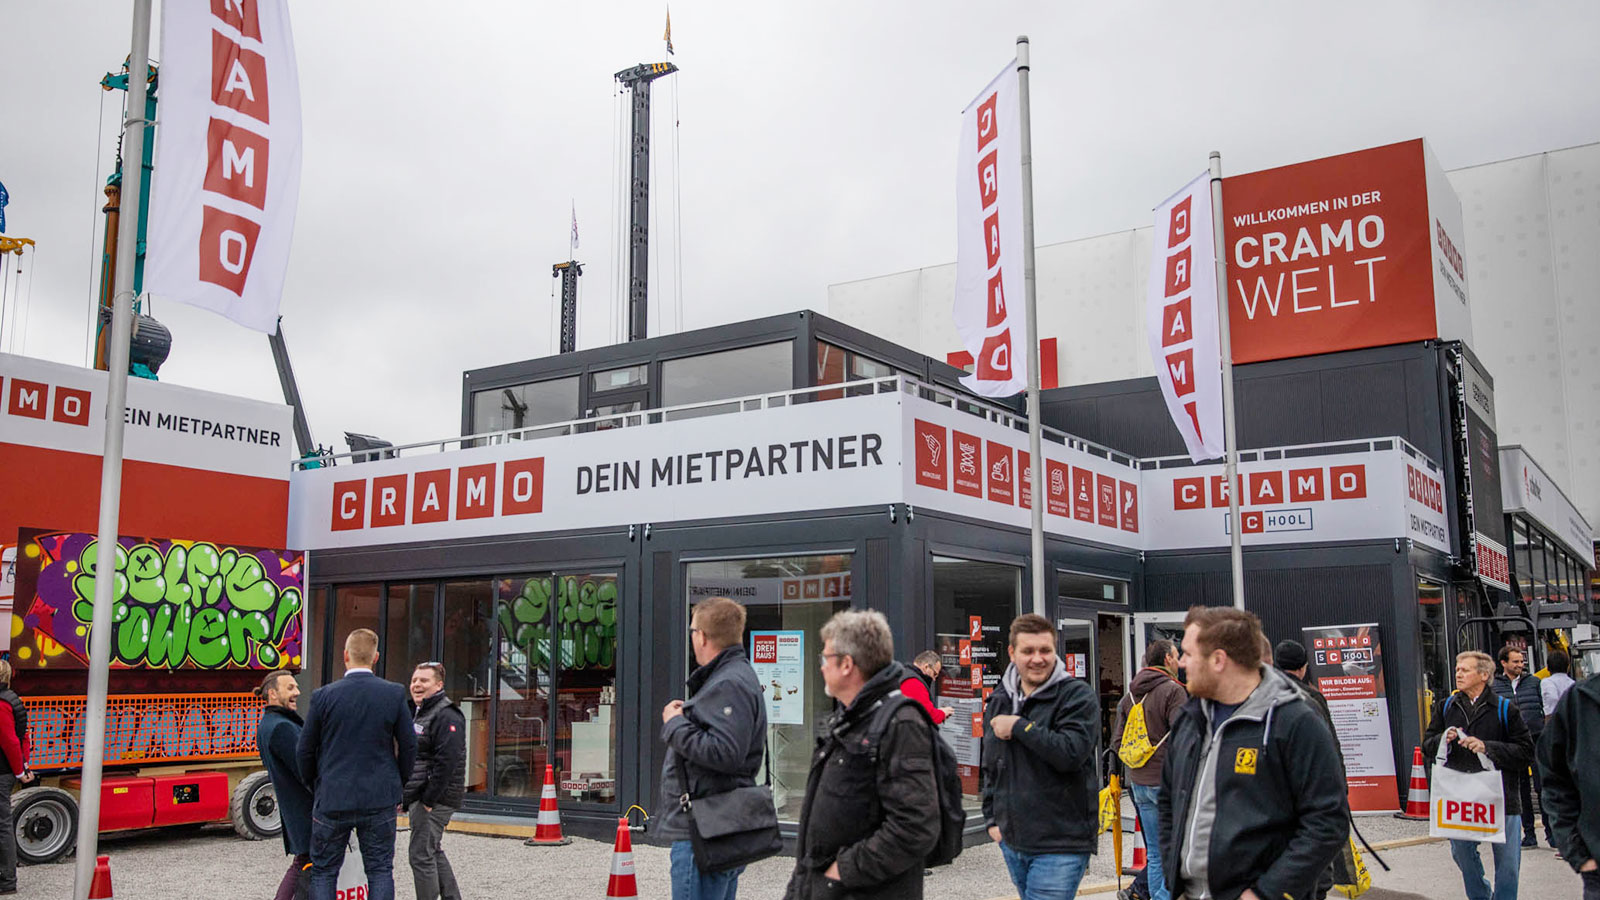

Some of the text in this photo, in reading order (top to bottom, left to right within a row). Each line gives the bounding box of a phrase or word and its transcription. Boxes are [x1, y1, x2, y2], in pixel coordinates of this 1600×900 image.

[1233, 191, 1381, 228] WILLKOMMEN IN DER
[1234, 214, 1386, 269] CRAMO
[1236, 256, 1387, 320] WELT
[157, 412, 281, 448] MIETPARTNER
[576, 433, 883, 495] DEIN MIETPARTNER
[340, 471, 533, 520] CRAMO
[1181, 472, 1357, 504] CRAMO
[756, 644, 775, 652] DREH
[1316, 637, 1369, 647] CRAMO
[1319, 652, 1369, 662] SCHOOL
[1446, 800, 1496, 824] PERI
